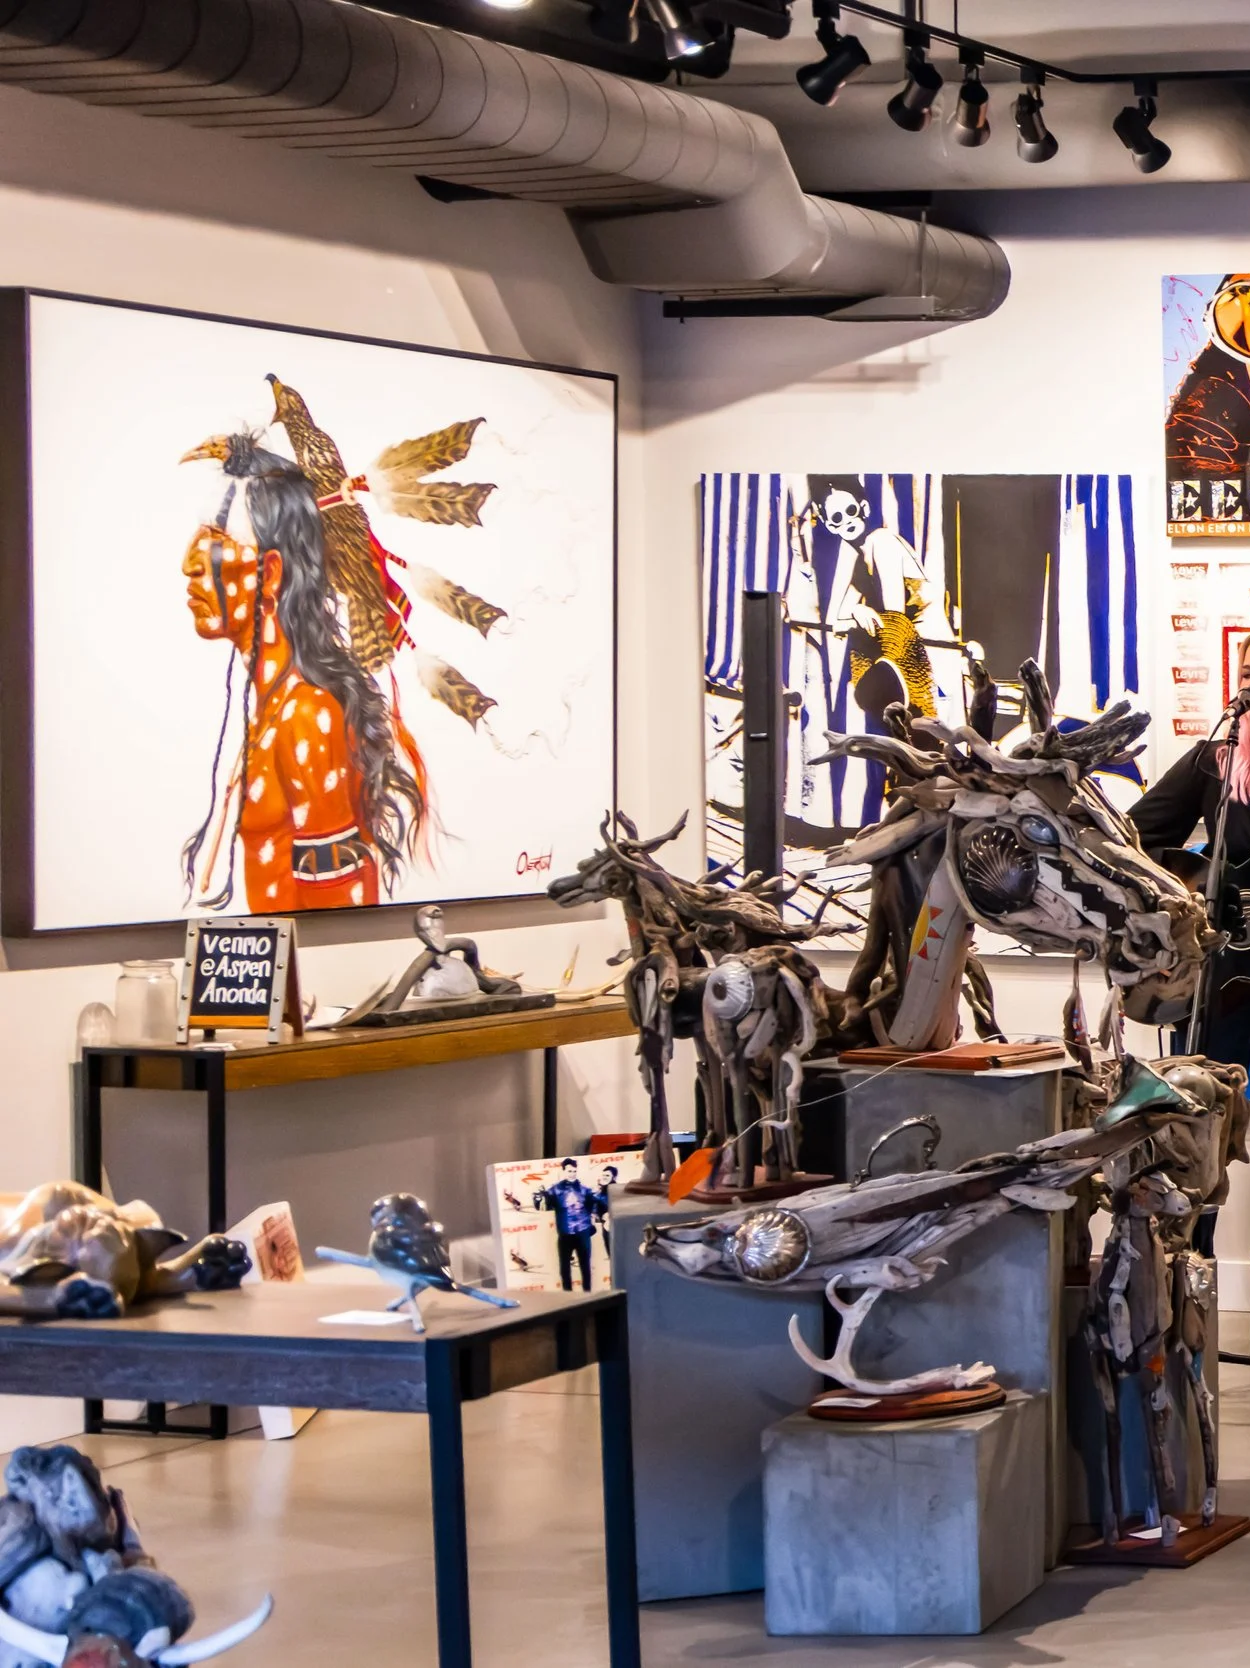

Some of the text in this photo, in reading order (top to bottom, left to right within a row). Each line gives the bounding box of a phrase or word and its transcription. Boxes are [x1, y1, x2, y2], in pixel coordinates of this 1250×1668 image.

[1168, 523, 1205, 533] ELTON
[1208, 523, 1245, 533] ELTON
[199, 976, 267, 1005] Anonda
